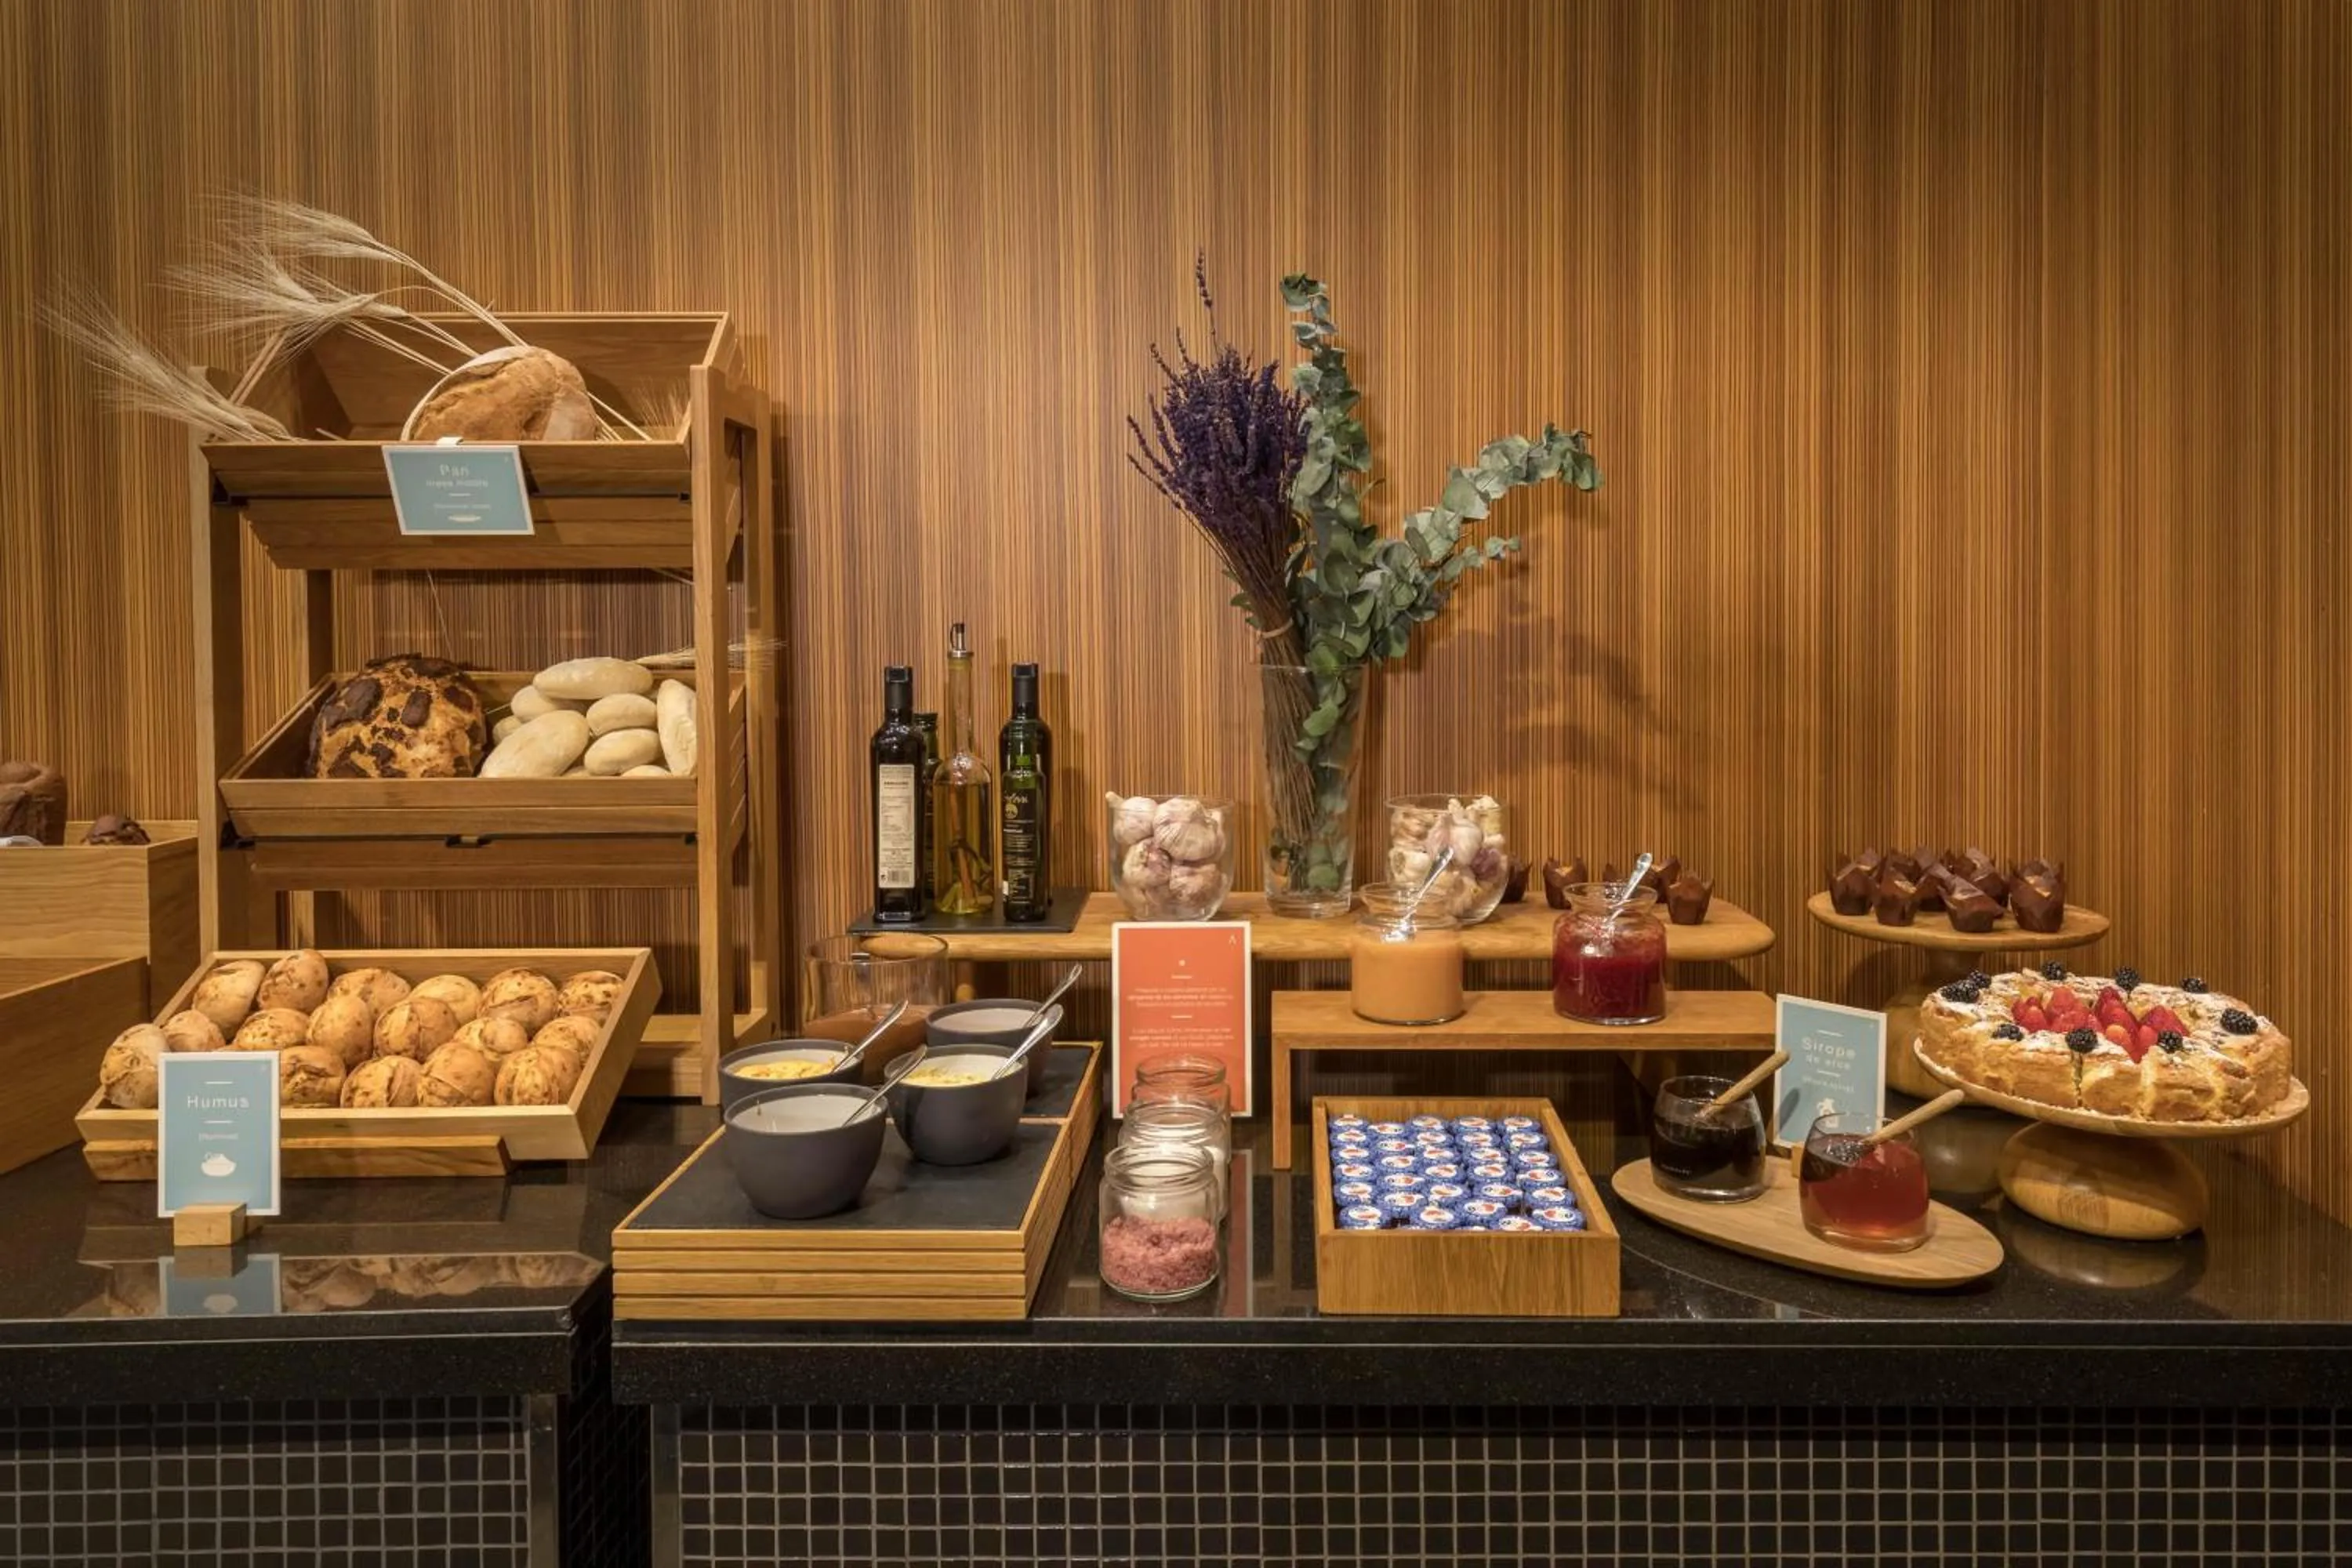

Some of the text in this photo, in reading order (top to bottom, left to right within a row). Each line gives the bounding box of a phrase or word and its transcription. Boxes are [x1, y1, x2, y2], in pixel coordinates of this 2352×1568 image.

[439, 463, 470, 477] Pan
[1802, 1036, 1856, 1060] Sirope
[187, 1094, 250, 1109] Humus
